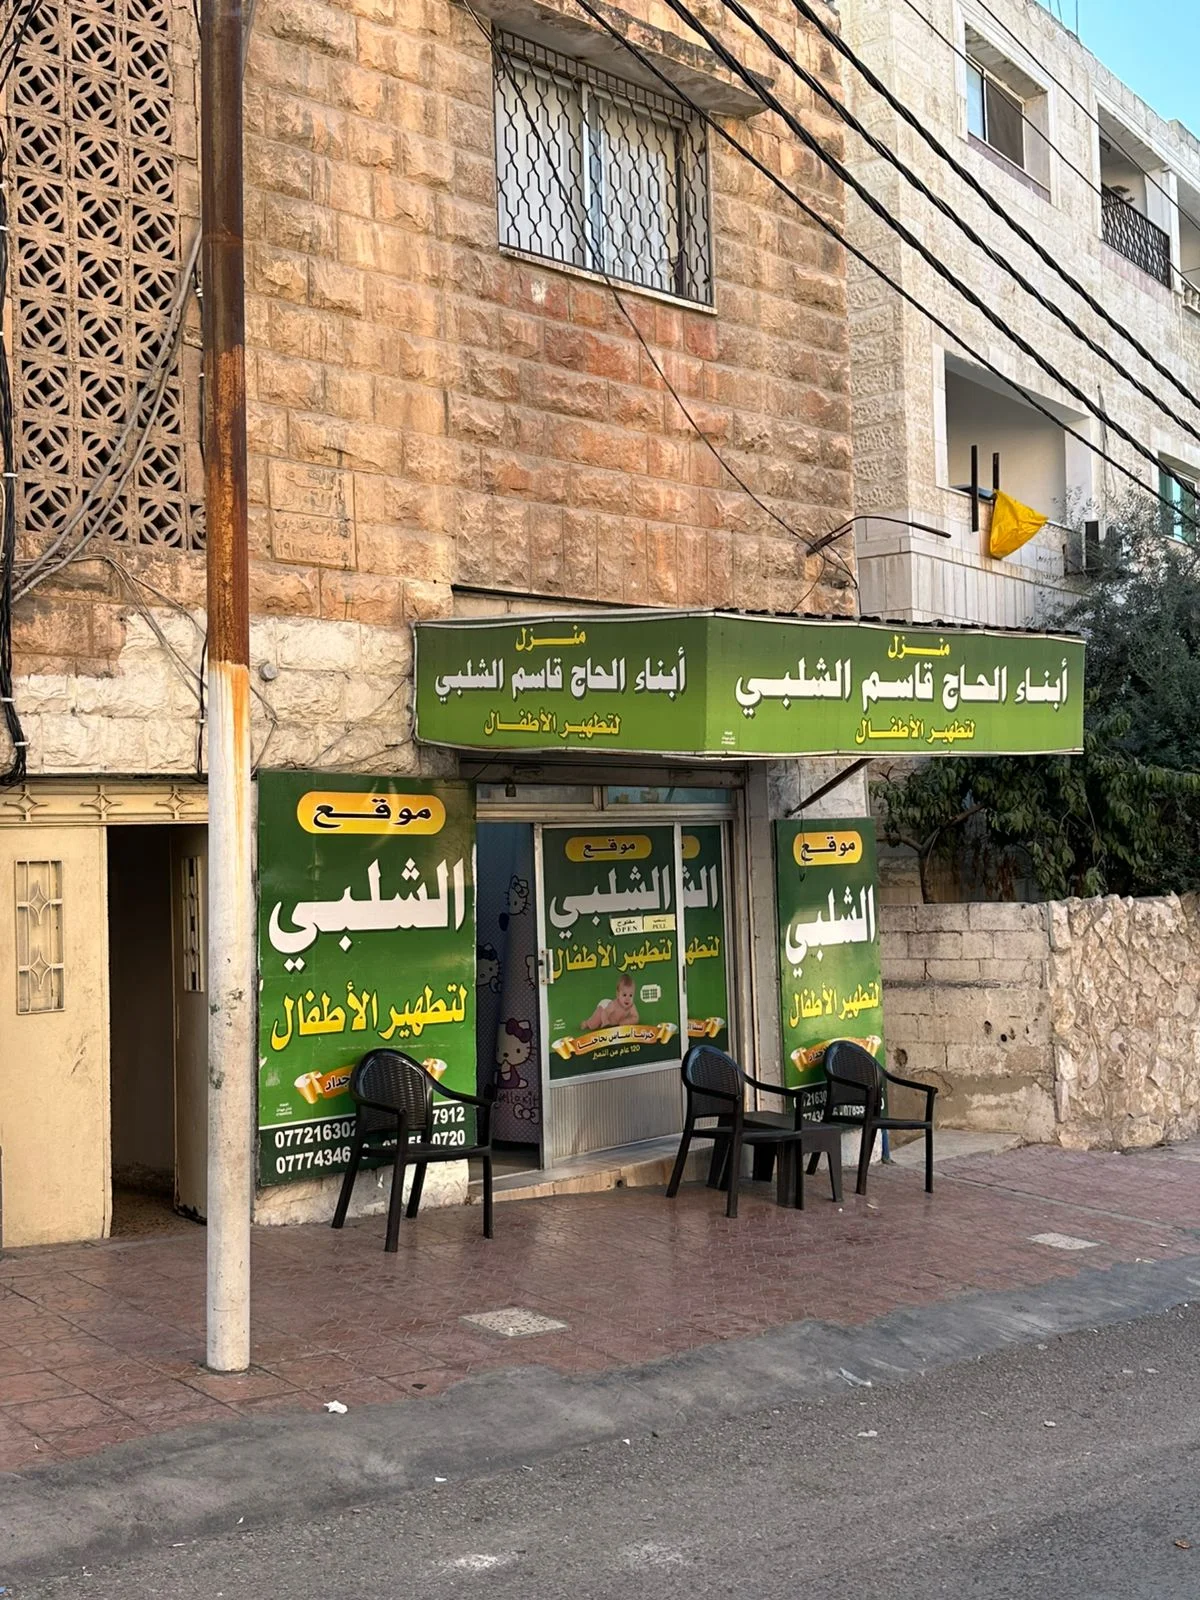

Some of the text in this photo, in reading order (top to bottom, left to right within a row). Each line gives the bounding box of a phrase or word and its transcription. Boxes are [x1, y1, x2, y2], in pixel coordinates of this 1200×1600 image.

[516, 624, 586, 652] منزل
[887, 634, 950, 659] منزل
[435, 646, 686, 702] أبناء الحاج قاسم الشلبي
[735, 657, 1068, 718] أبناء الحاج قاسم الشلبي
[484, 708, 621, 738] لتطهير الأطفال
[855, 715, 975, 744] لتطهير الأطفال
[313, 798, 432, 829] موقع
[583, 839, 636, 859] موقع
[801, 835, 855, 862] موقع
[269, 857, 465, 972] الشلبي
[550, 865, 671, 939] الشلبي
[785, 884, 876, 979] الشلبي
[552, 938, 672, 980] لتطهير الأطفال
[271, 981, 468, 1050] لتطهير الأطفال
[789, 982, 880, 1028] لتطهير الأطفال
[630, 1044, 641, 1053] 120
